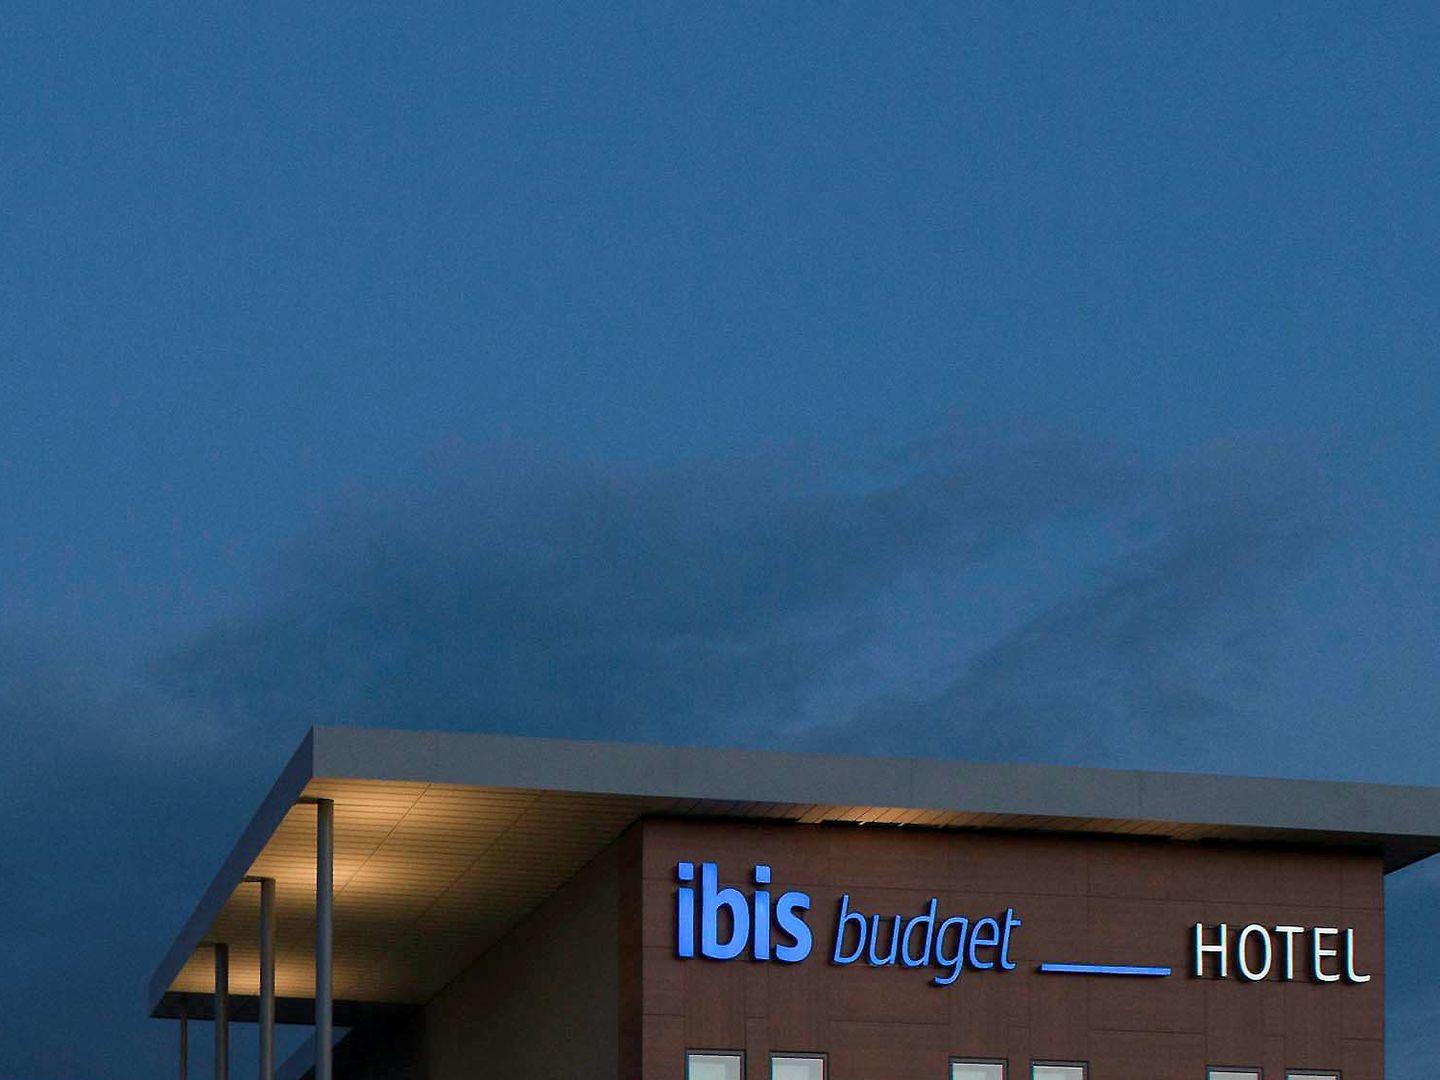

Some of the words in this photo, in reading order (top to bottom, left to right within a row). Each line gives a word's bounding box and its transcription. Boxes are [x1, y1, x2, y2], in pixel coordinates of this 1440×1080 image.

[677, 862, 813, 961] ibis
[833, 894, 1022, 985] budget
[1195, 922, 1371, 983] HOTEL
